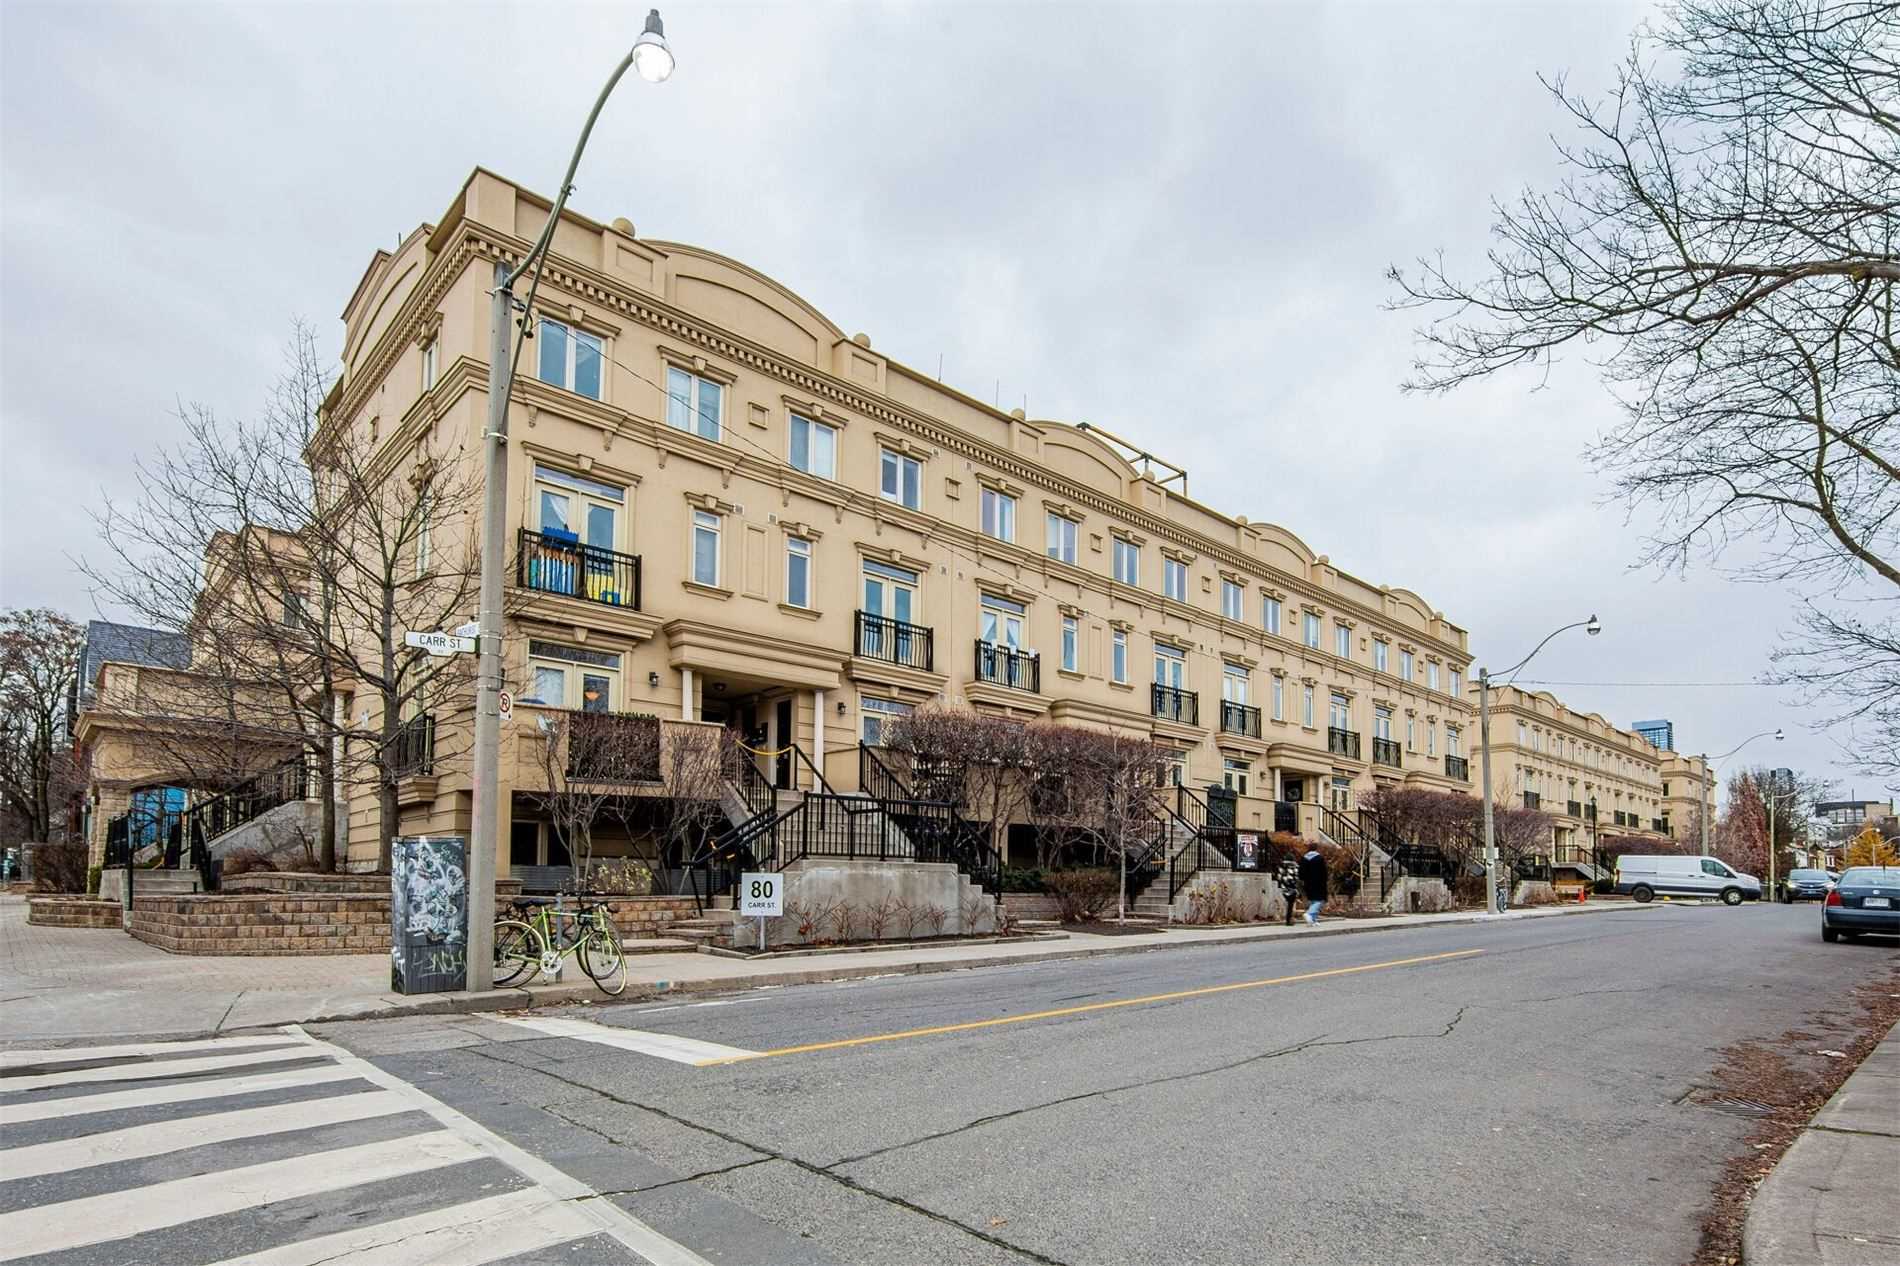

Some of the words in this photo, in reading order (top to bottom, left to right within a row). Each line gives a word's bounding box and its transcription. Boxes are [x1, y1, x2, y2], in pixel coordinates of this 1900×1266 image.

[420, 634, 446, 647] CARR
[449, 638, 461, 649] ST
[751, 880, 773, 898] 80
